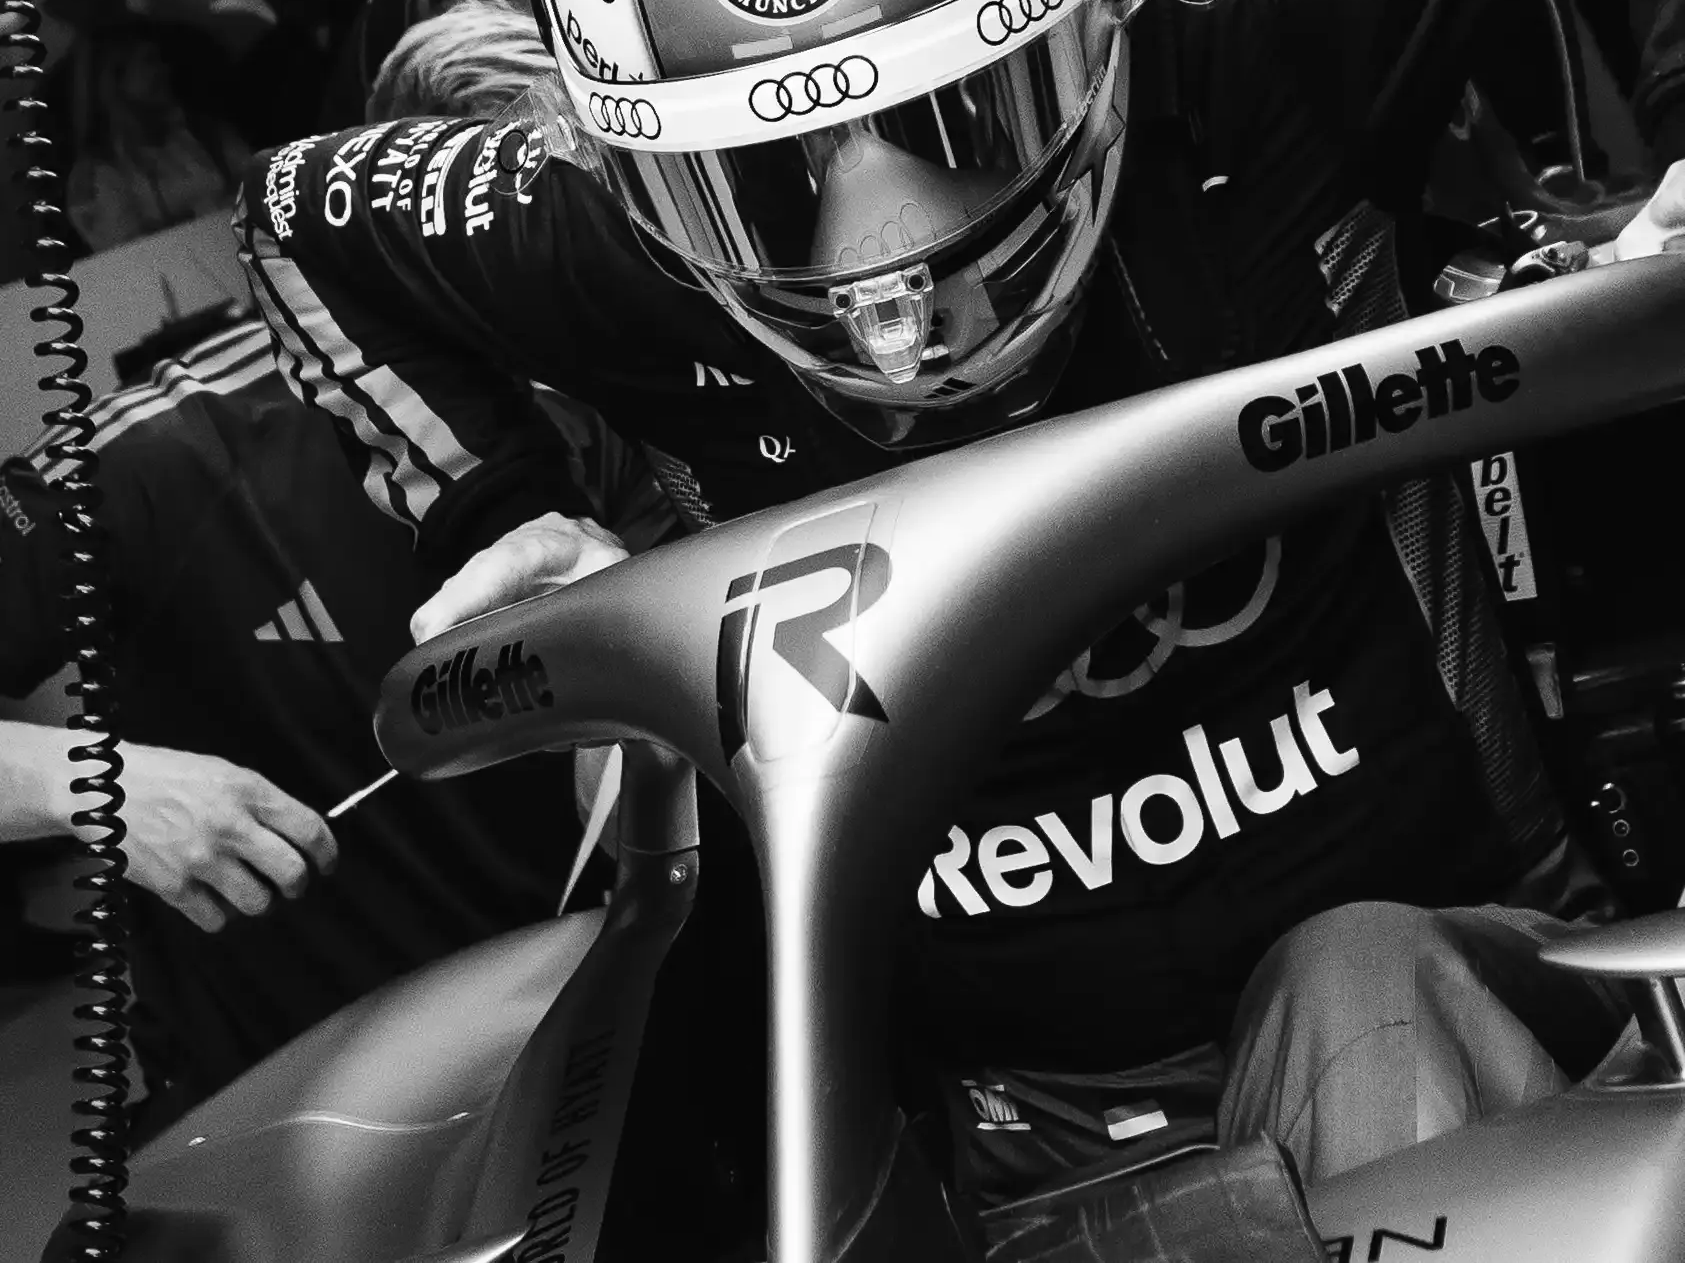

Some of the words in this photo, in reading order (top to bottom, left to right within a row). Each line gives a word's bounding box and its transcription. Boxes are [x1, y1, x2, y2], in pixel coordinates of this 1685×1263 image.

[396, 178, 414, 211] OF
[1238, 338, 1521, 472] Gillette
[410, 640, 555, 736] Gillette
